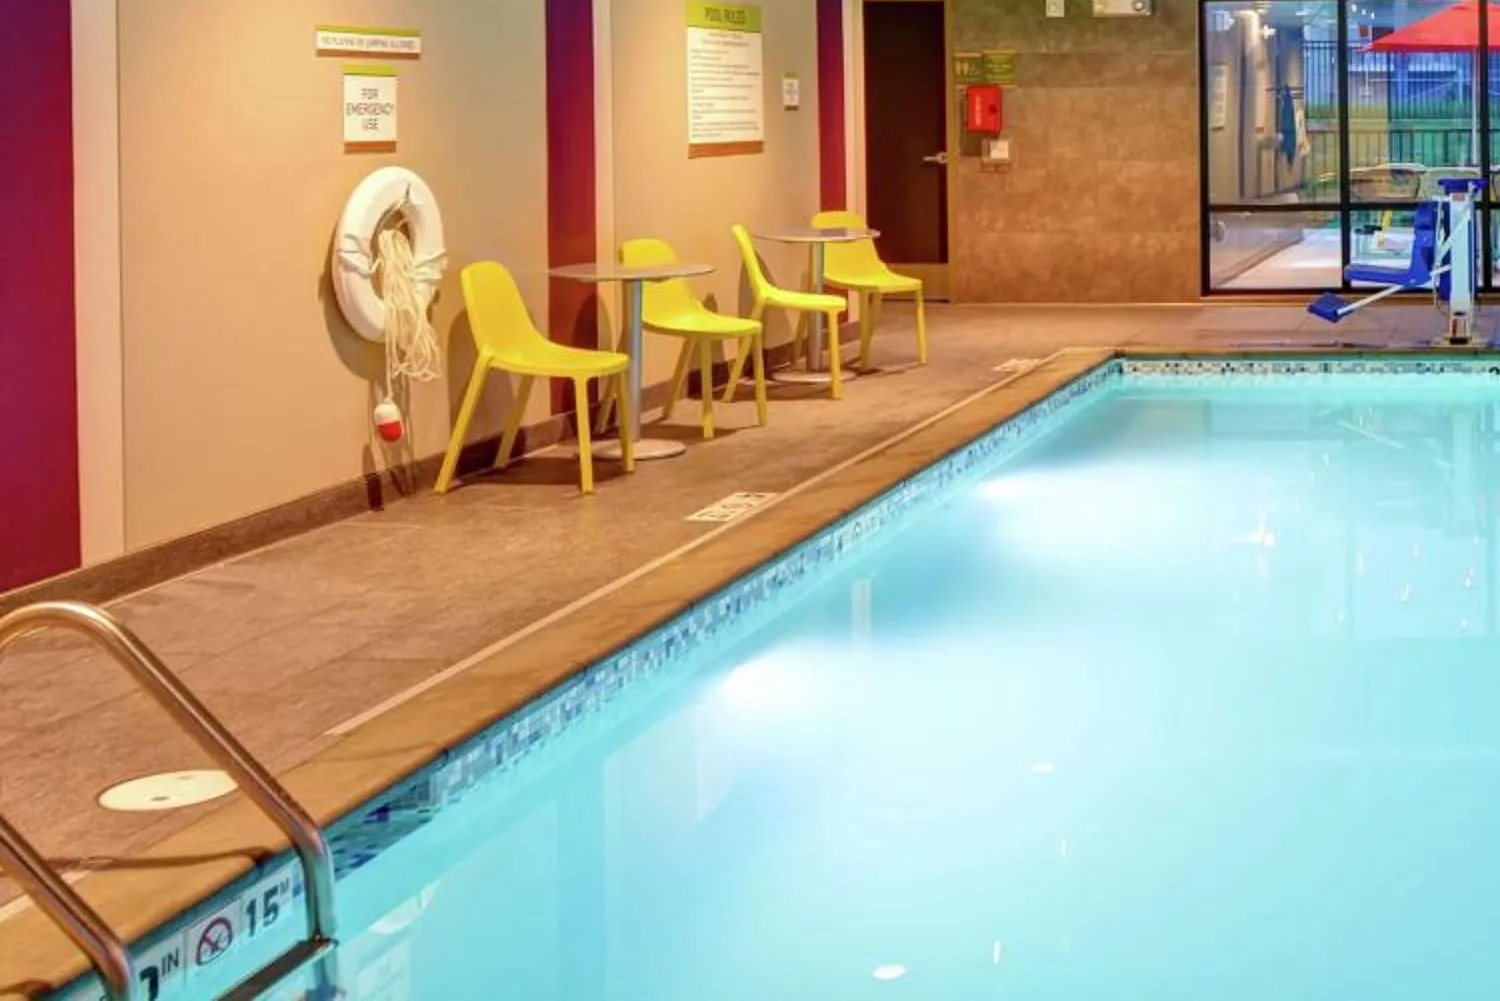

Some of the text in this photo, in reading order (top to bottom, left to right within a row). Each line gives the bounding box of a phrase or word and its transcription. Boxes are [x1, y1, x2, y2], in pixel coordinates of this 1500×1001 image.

[360, 87, 379, 100] FOR
[346, 102, 395, 116] EMERGENCY
[362, 118, 379, 130] USE
